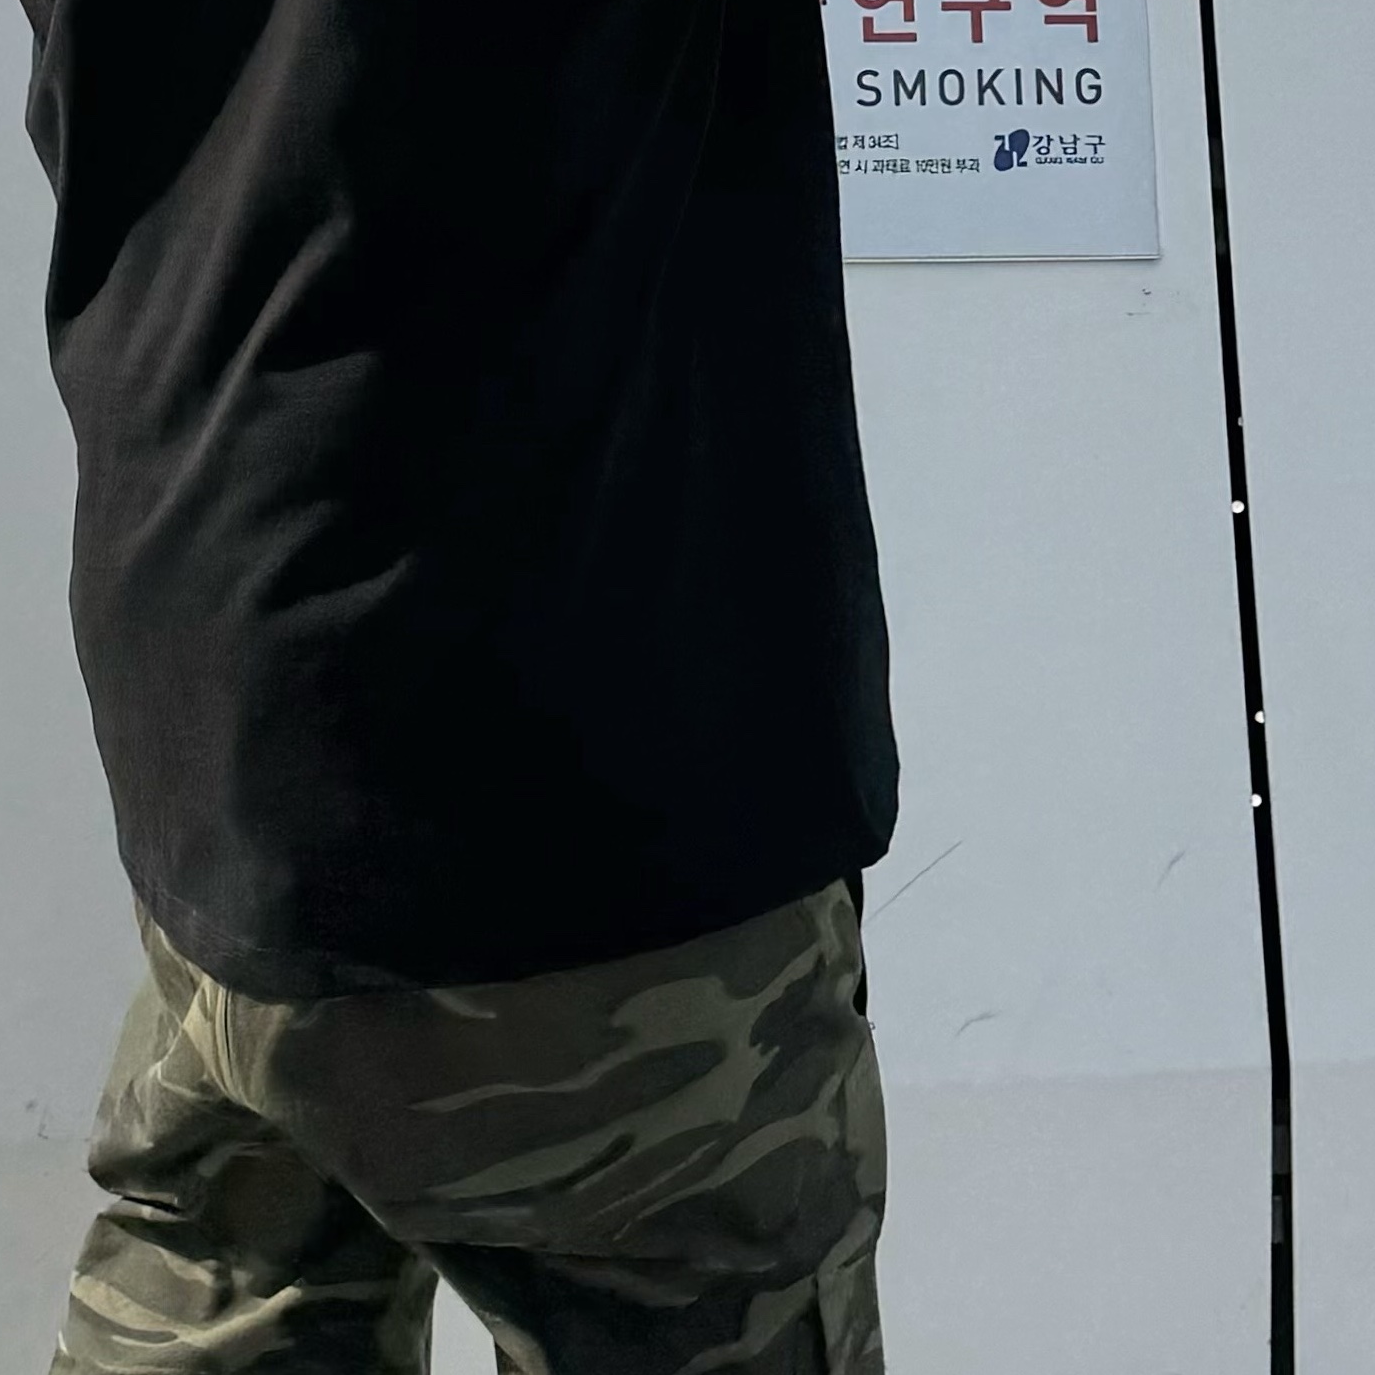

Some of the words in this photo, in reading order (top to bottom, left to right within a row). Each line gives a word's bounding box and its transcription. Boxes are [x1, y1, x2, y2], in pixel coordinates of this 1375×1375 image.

[856, 68, 1103, 107] SMOKING
[1032, 134, 1106, 156] 강남구
[854, 159, 868, 174] 시
